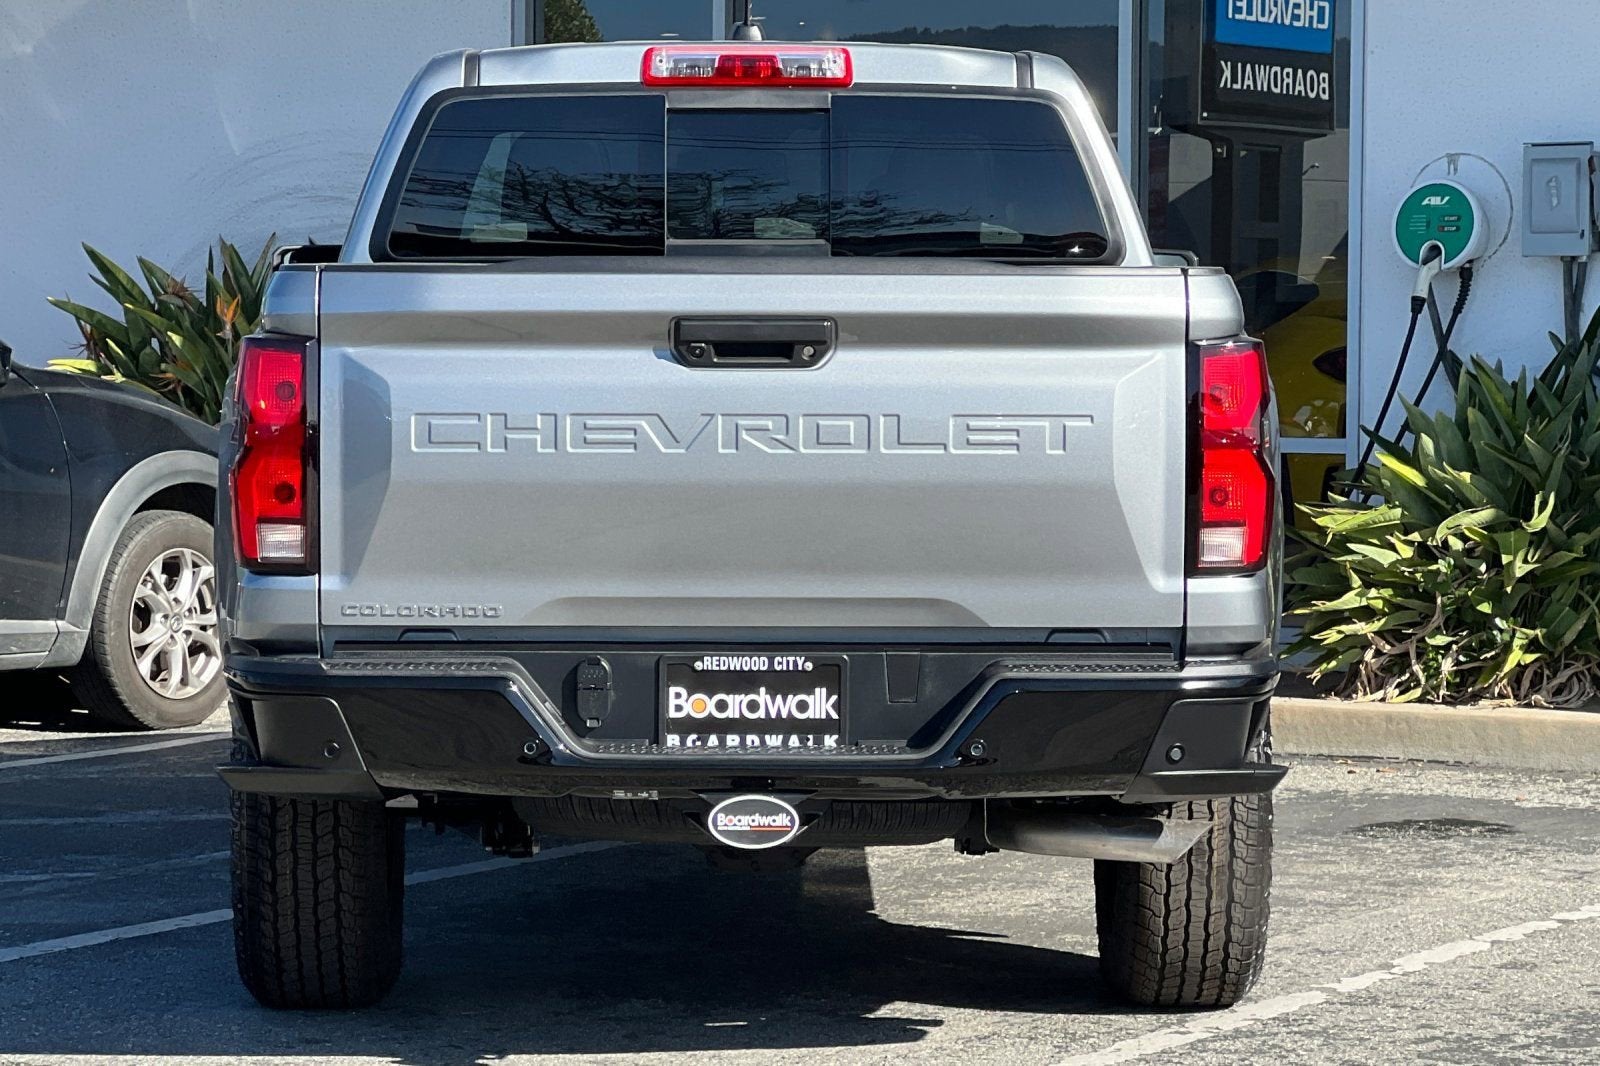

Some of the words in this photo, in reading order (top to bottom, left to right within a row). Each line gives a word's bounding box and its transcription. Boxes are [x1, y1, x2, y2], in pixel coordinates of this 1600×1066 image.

[411, 412, 1094, 454] CHEVROLET
[340, 602, 505, 618] COLORADO
[703, 656, 769, 672] REDWOOD
[774, 656, 806, 672] CITY
[668, 686, 839, 720] Boardwalk
[717, 813, 792, 827] Boardwalk
